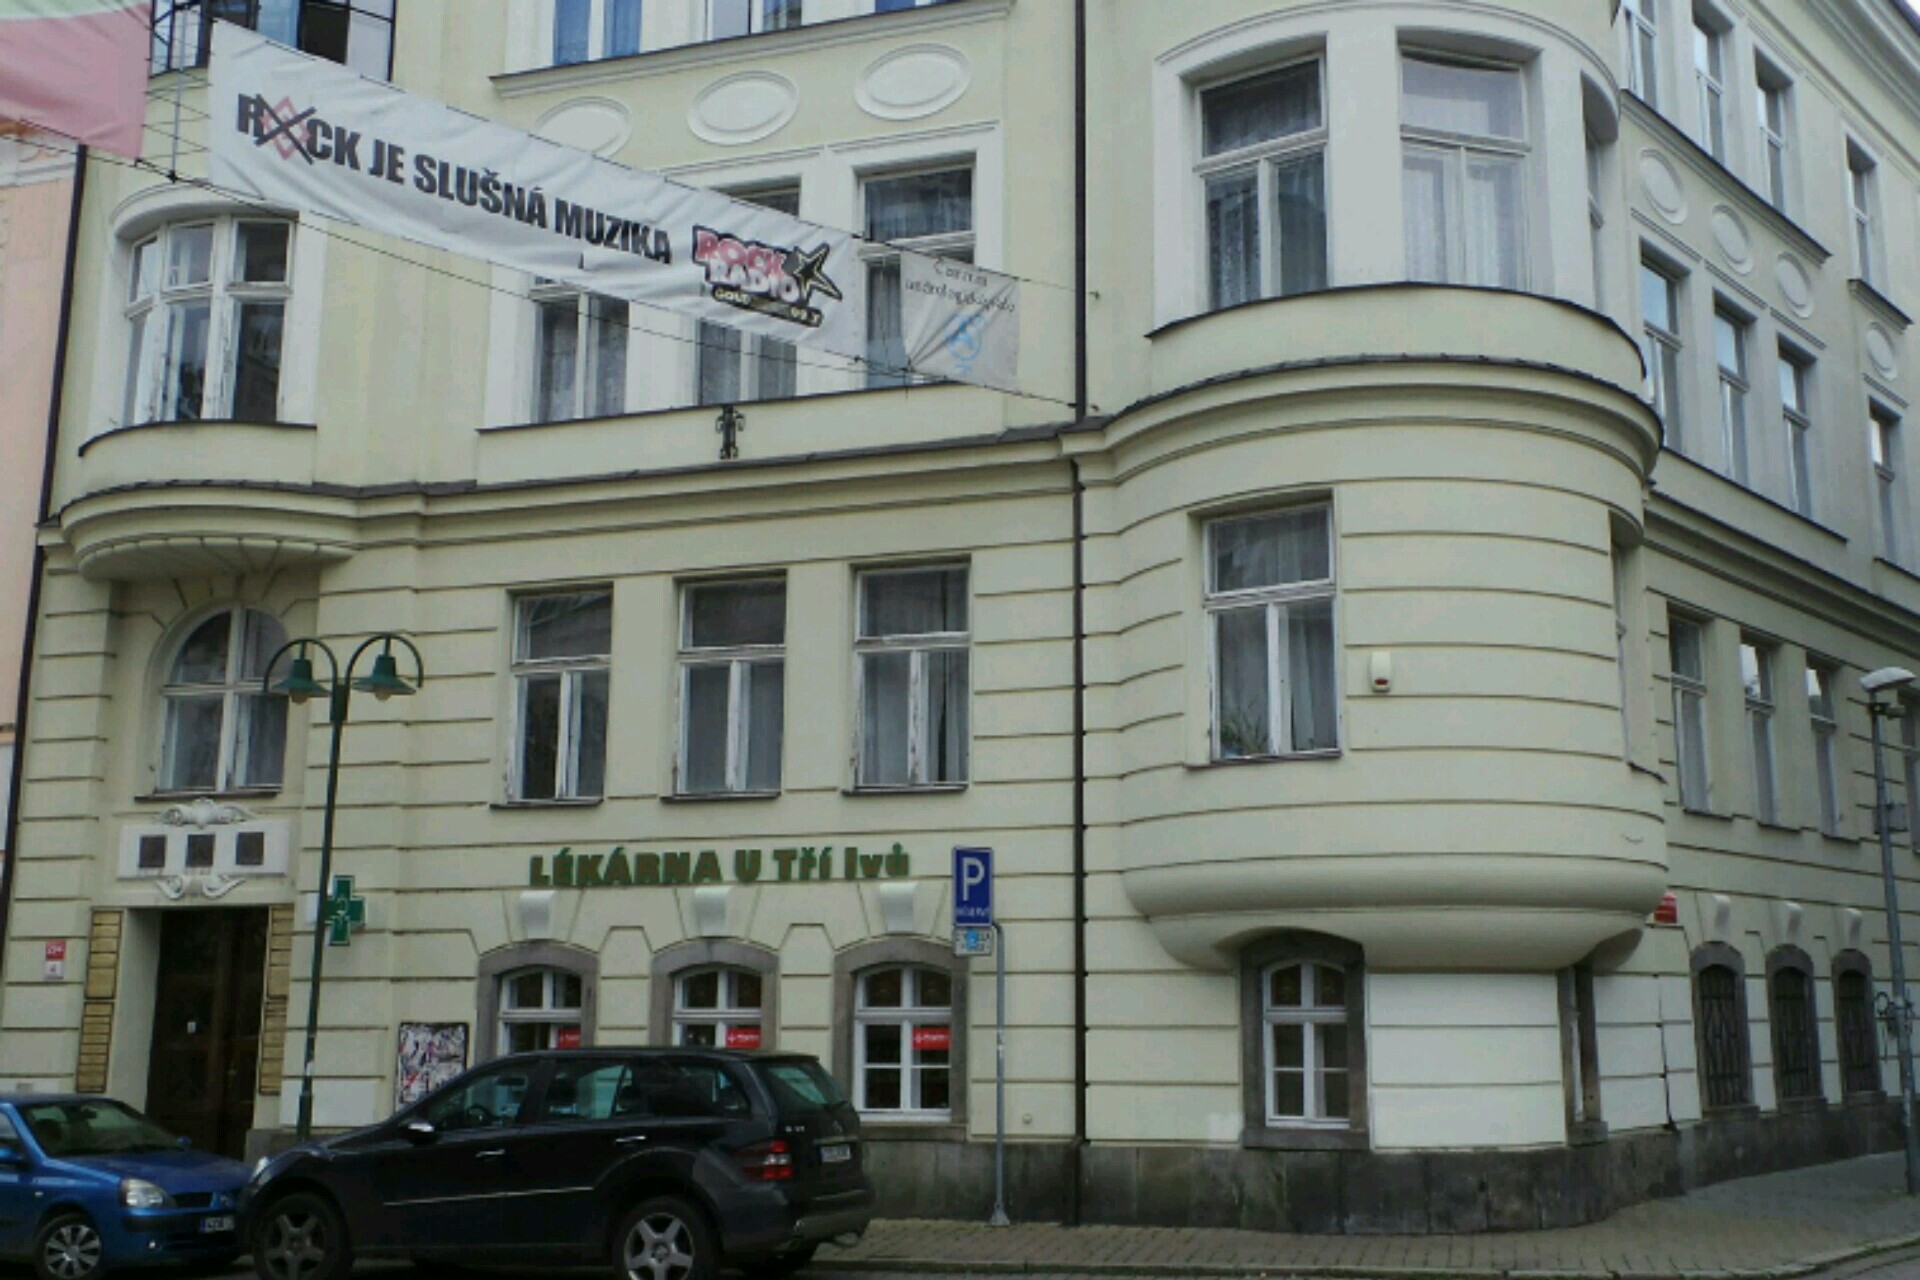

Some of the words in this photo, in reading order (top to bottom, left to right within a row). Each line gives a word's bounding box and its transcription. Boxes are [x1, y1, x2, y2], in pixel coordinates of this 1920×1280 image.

[368, 138, 405, 185] JE
[413, 153, 548, 229] SLUŠNÁ
[555, 198, 672, 265] MUZIKA
[694, 228, 787, 278] ROCK
[708, 257, 800, 304] RADIO
[530, 846, 722, 887] LÉKÁRNA
[735, 849, 762, 883] U
[773, 846, 832, 882] Tří
[962, 856, 985, 901] P
